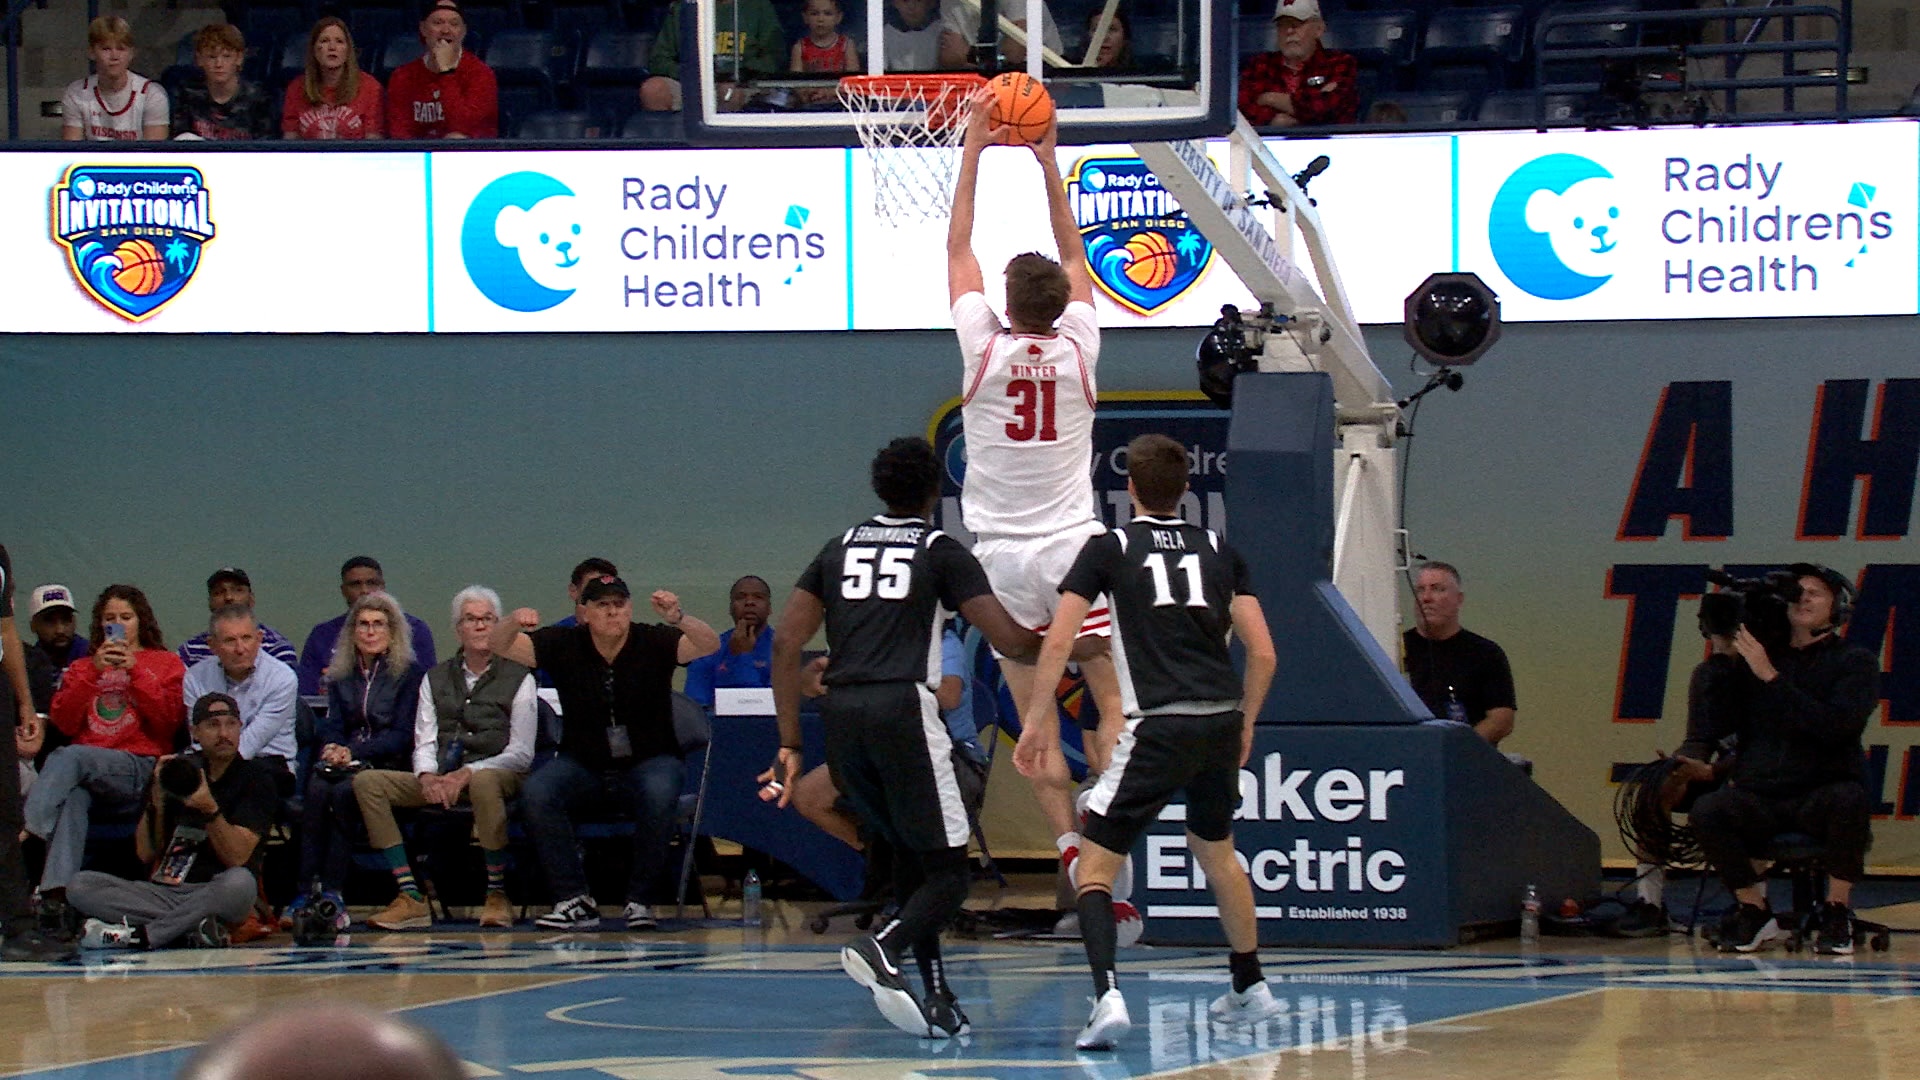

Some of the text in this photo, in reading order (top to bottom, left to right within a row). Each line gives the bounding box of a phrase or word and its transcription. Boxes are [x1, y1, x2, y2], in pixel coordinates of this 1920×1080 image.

[97, 182, 132, 197] Rady
[1107, 174, 1143, 189] Rady
[1664, 153, 1783, 200] Rady
[60, 190, 213, 235] INVITATIONAL
[622, 175, 727, 220] Rady
[101, 227, 173, 237] SAN DIEGO
[1111, 219, 1186, 230] SAN DIEGO
[624, 272, 761, 307] Health
[1664, 254, 1817, 293] Health
[1011, 365, 1057, 377] WINTER
[1005, 379, 1057, 441] 31
[1151, 529, 1187, 550] MELA
[842, 548, 916, 600] 55
[1143, 552, 1208, 607] 11
[1158, 752, 1404, 822] aker
[1289, 906, 1407, 919] Established 1938
